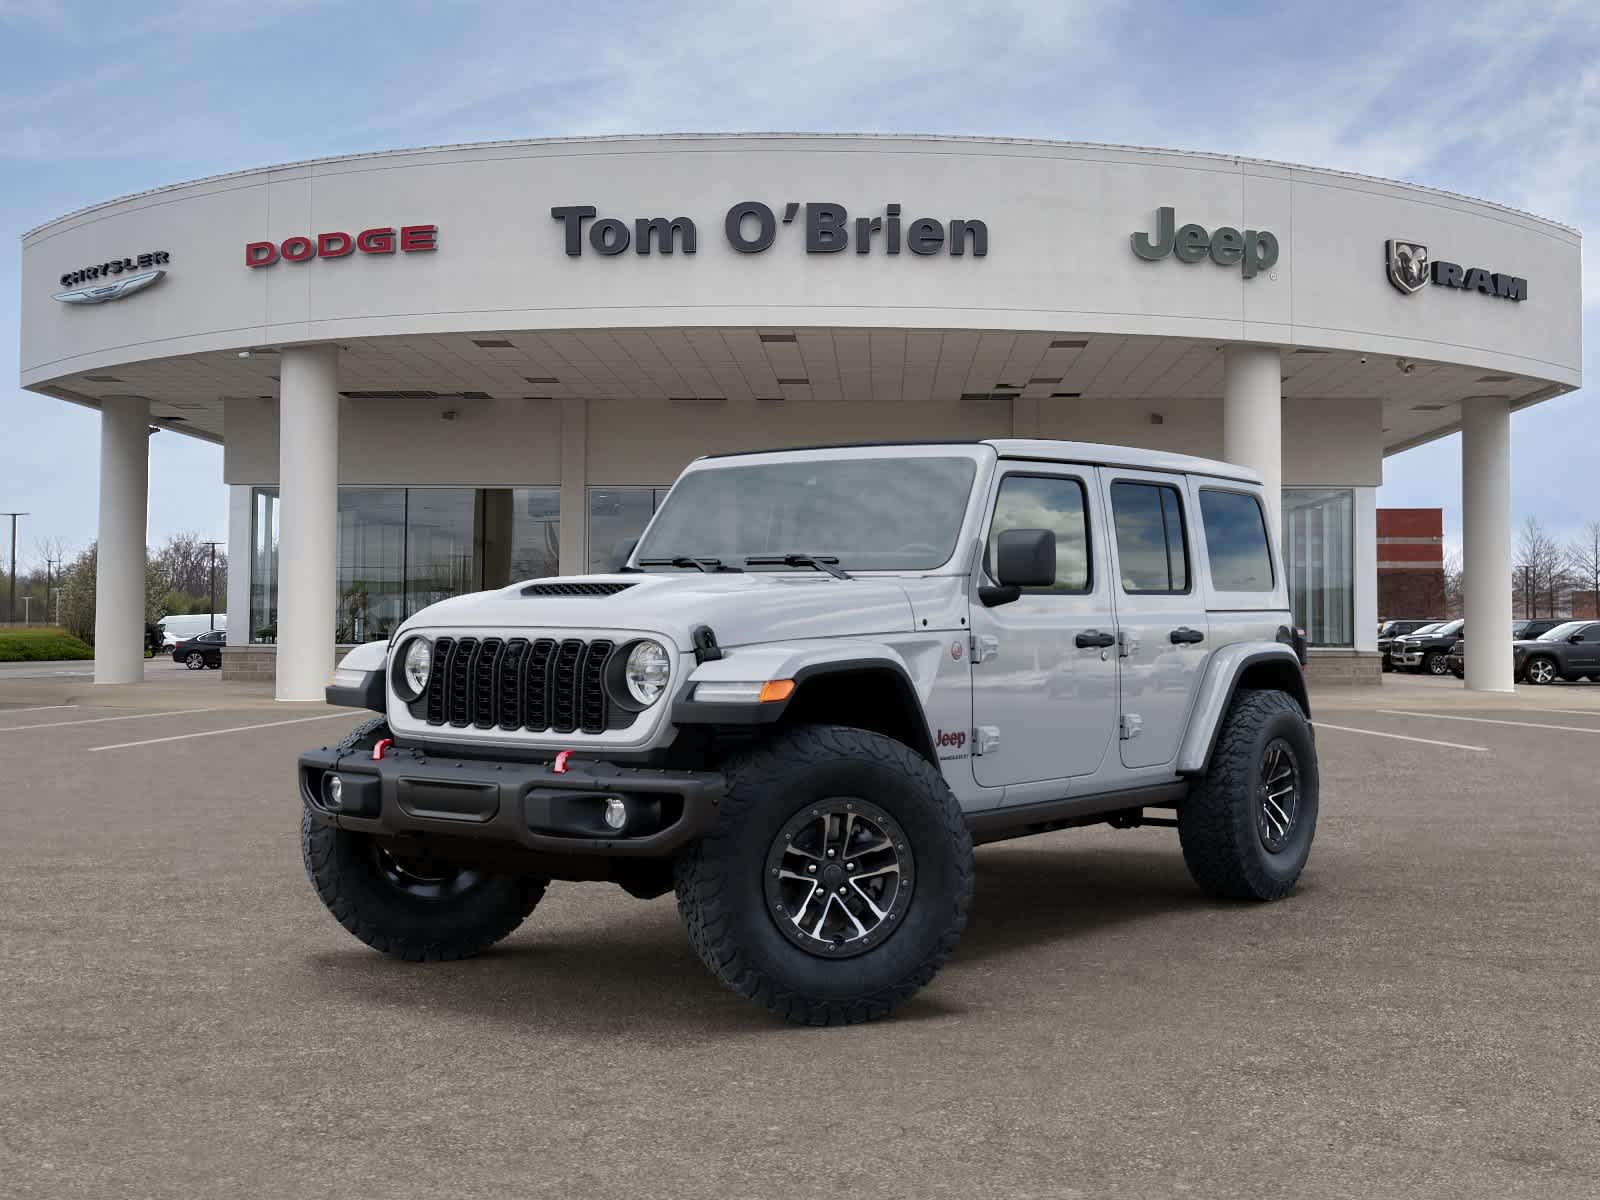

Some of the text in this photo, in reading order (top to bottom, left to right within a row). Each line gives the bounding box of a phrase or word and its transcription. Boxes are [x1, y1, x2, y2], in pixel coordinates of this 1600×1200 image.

[245, 224, 437, 268] DODGE
[551, 201, 989, 256] Tom O'Brien
[1130, 207, 1280, 278] Jeep
[60, 249, 170, 287] CHRYSLER
[1430, 260, 1528, 301] RAM
[935, 728, 967, 749] Jeep
